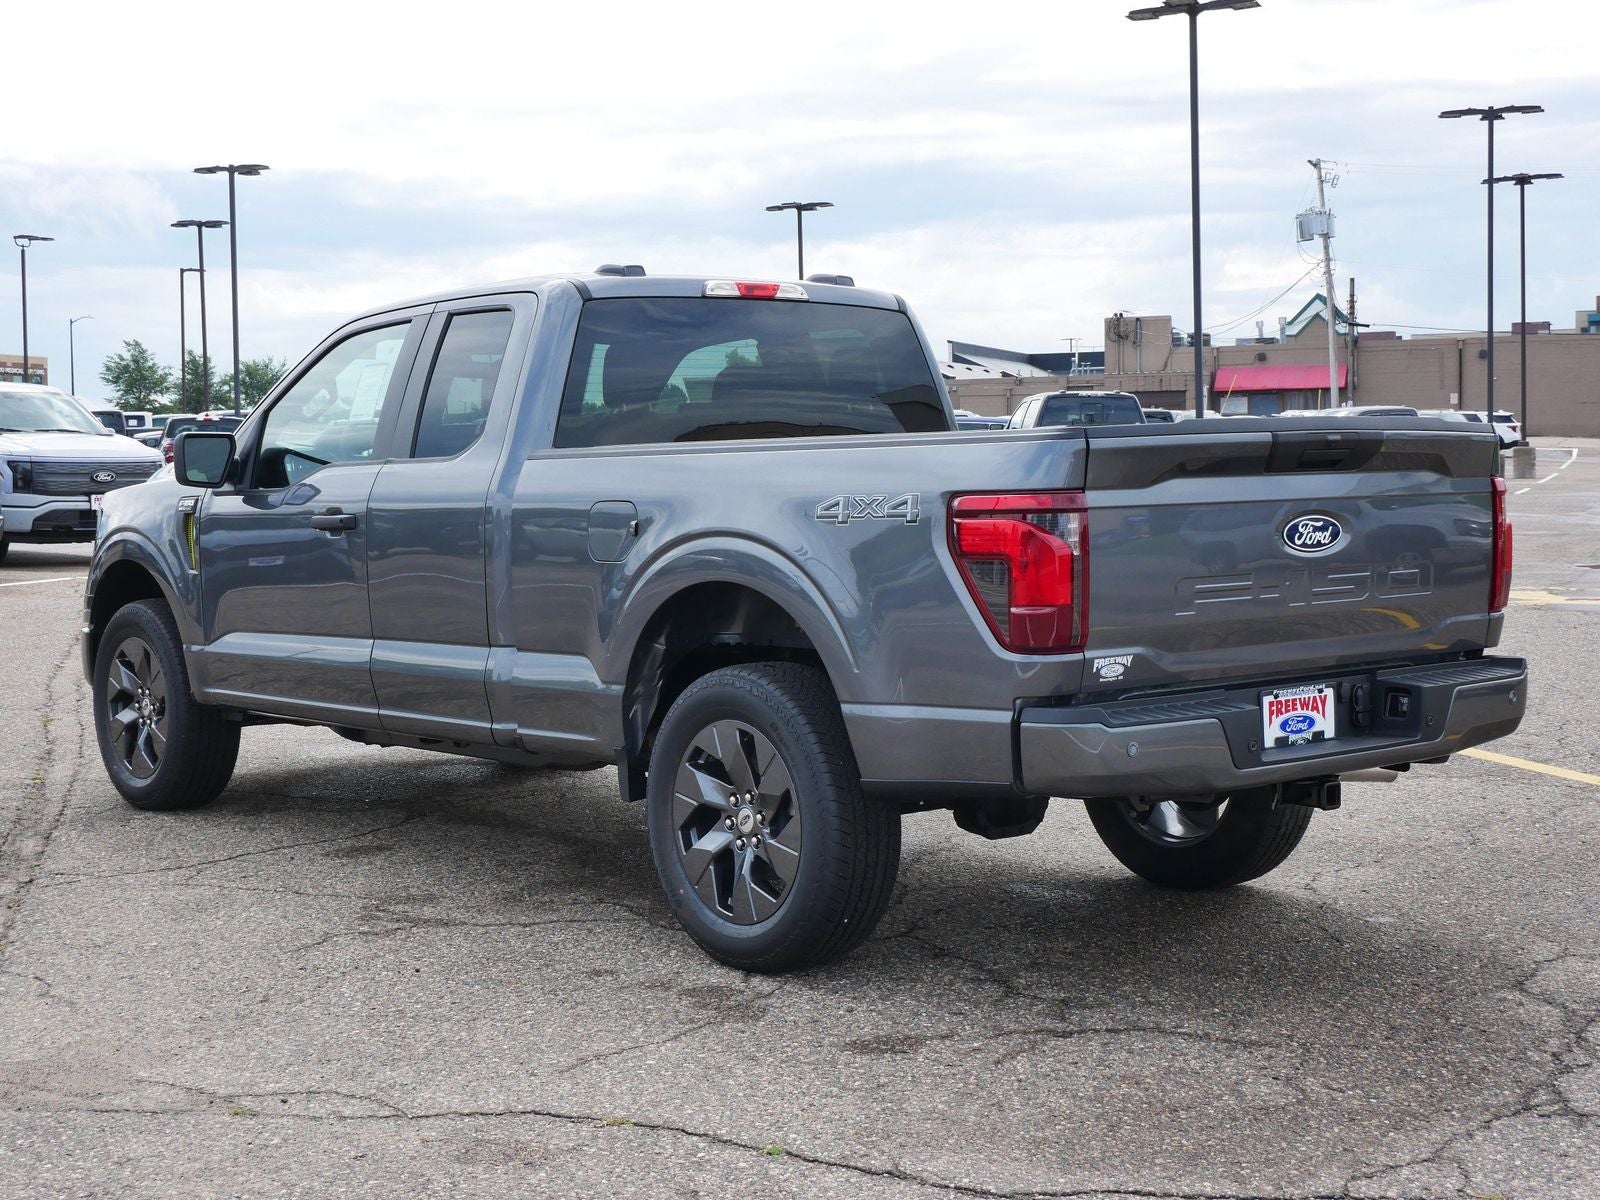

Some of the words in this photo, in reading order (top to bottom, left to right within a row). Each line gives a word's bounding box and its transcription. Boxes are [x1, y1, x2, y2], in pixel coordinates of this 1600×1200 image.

[815, 493, 920, 525] 4X4
[1294, 519, 1333, 546] Ford
[1174, 560, 1435, 616] F-150
[1092, 655, 1134, 673] FREEWAY
[1268, 694, 1328, 729] FREEWAY
[1285, 716, 1310, 732] Ford
